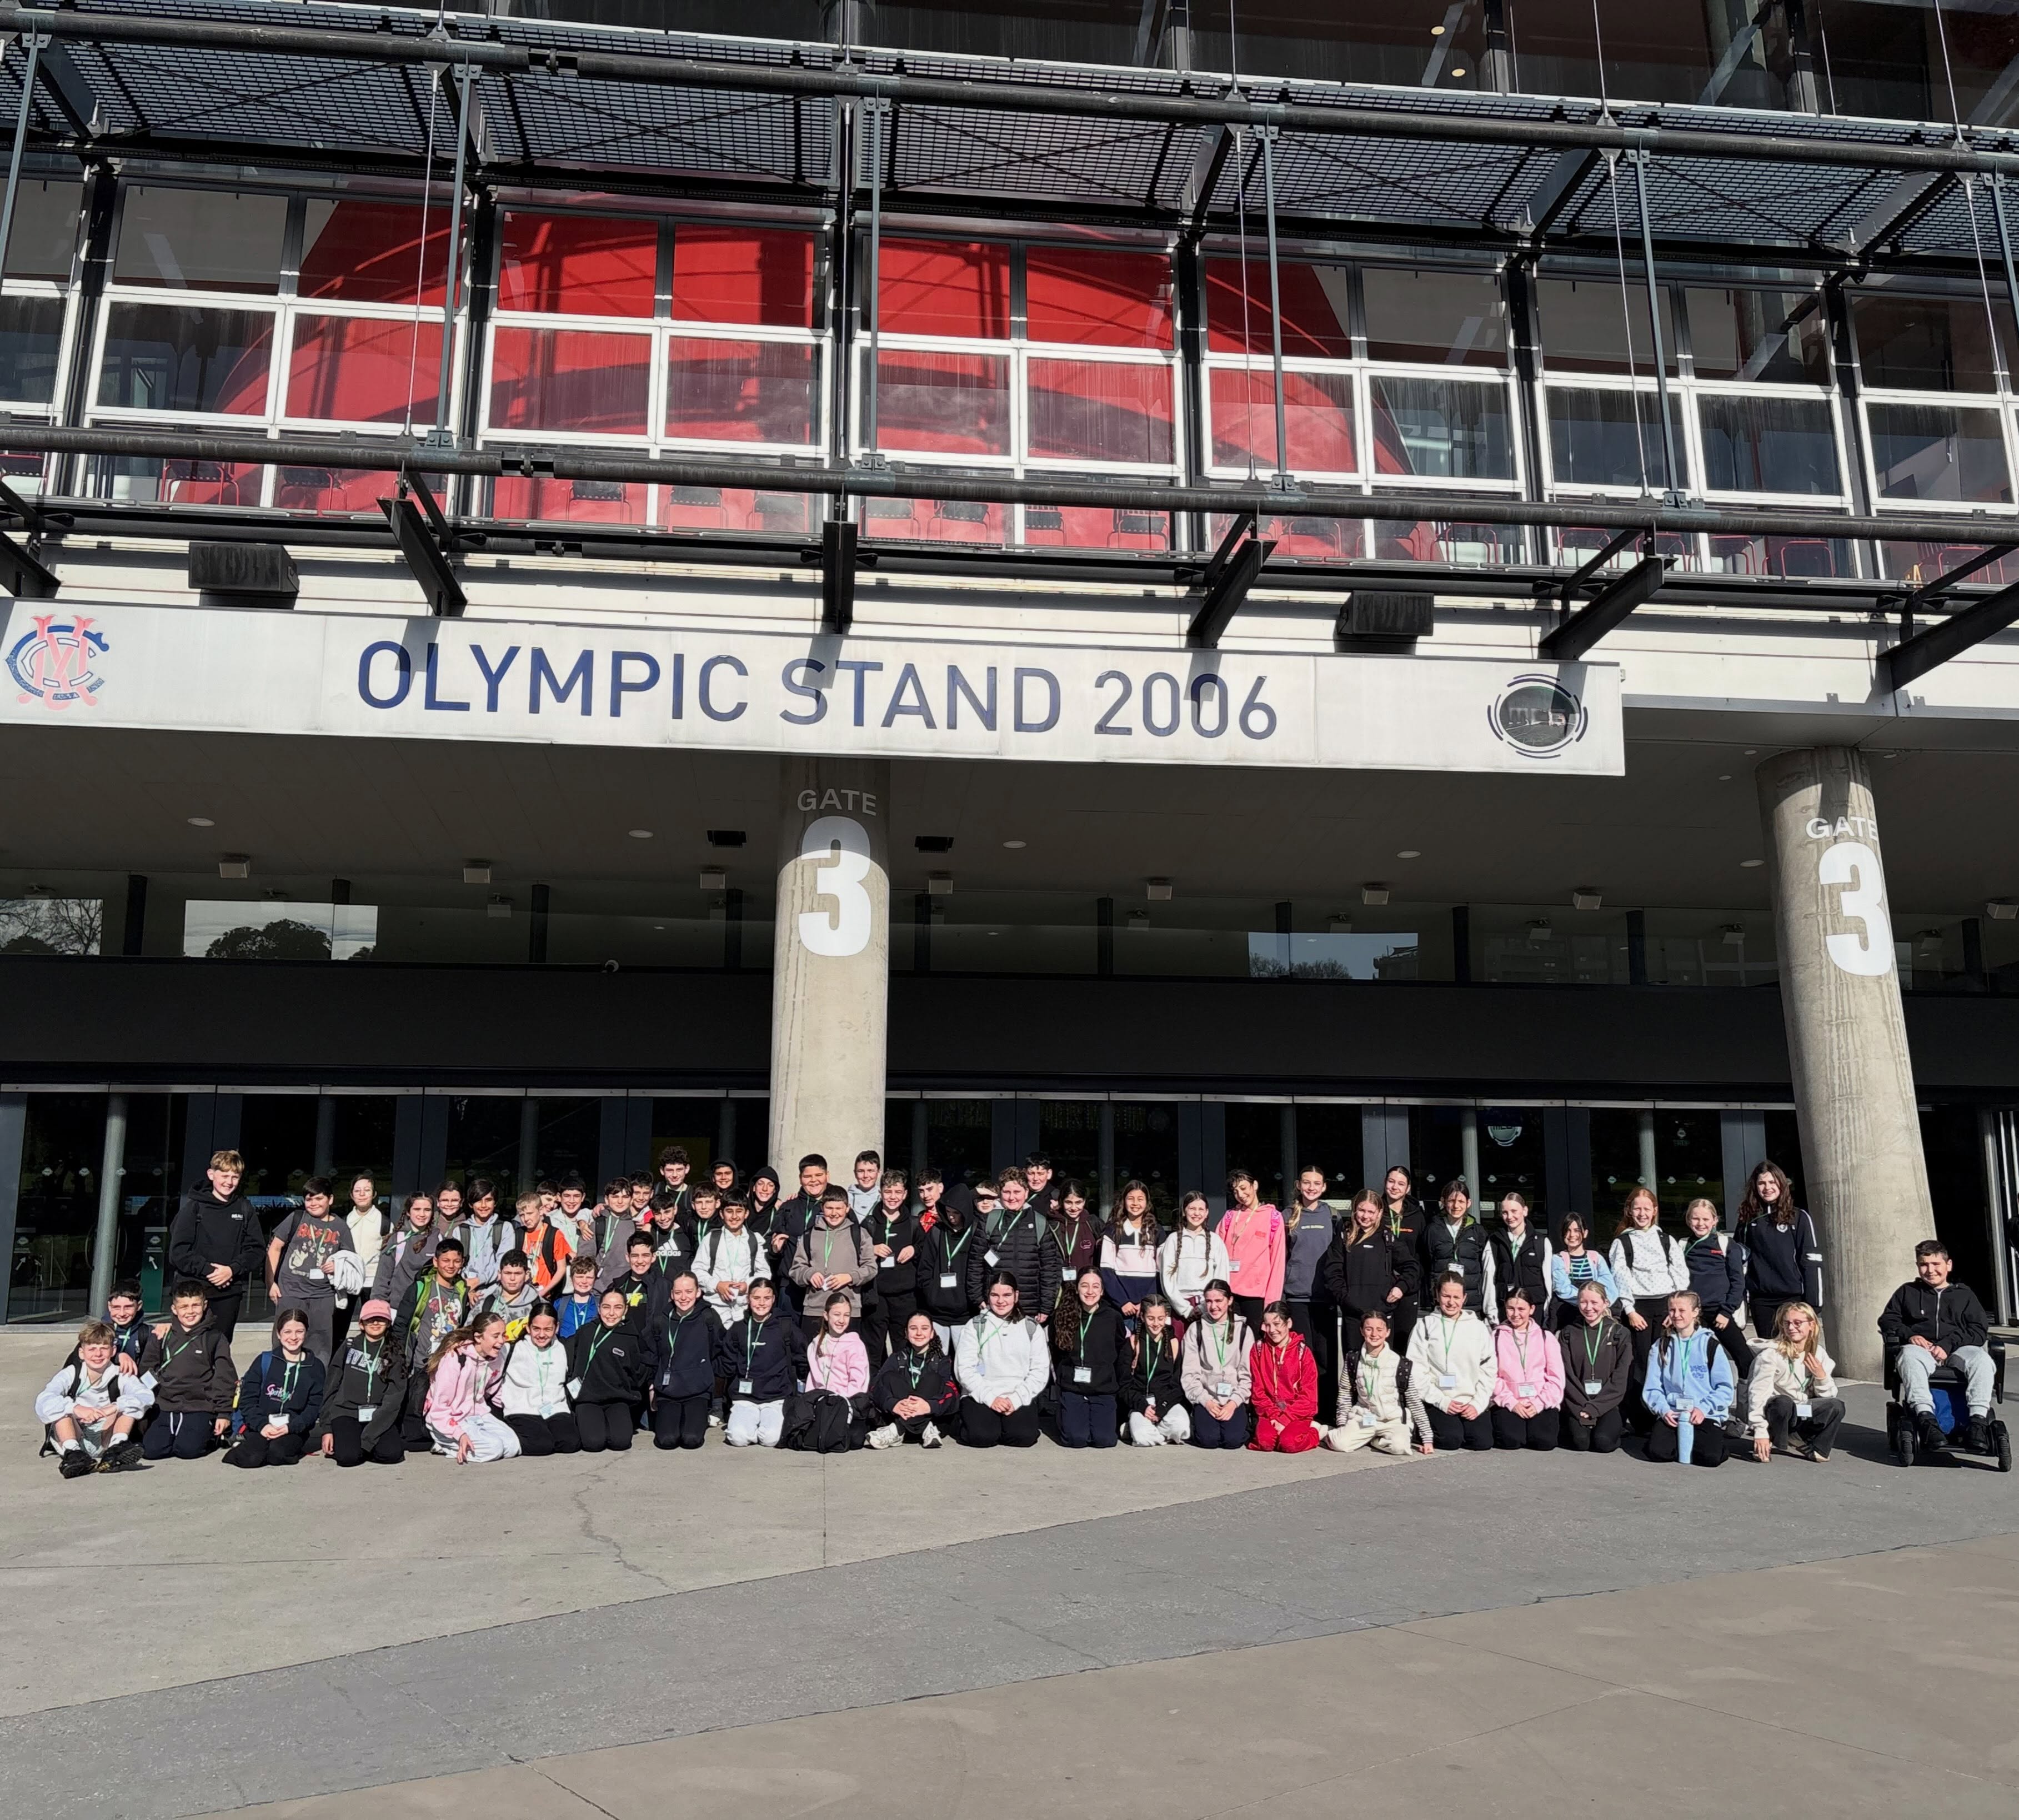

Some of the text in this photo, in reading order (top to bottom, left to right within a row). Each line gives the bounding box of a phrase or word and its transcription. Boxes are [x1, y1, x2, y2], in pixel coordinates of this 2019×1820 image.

[358, 640, 1277, 740] OLYMPIC STAND 2006
[797, 789, 876, 816] GATE
[1806, 816, 1878, 841] GATE
[798, 816, 871, 957] 3
[1818, 841, 1892, 976] 3
